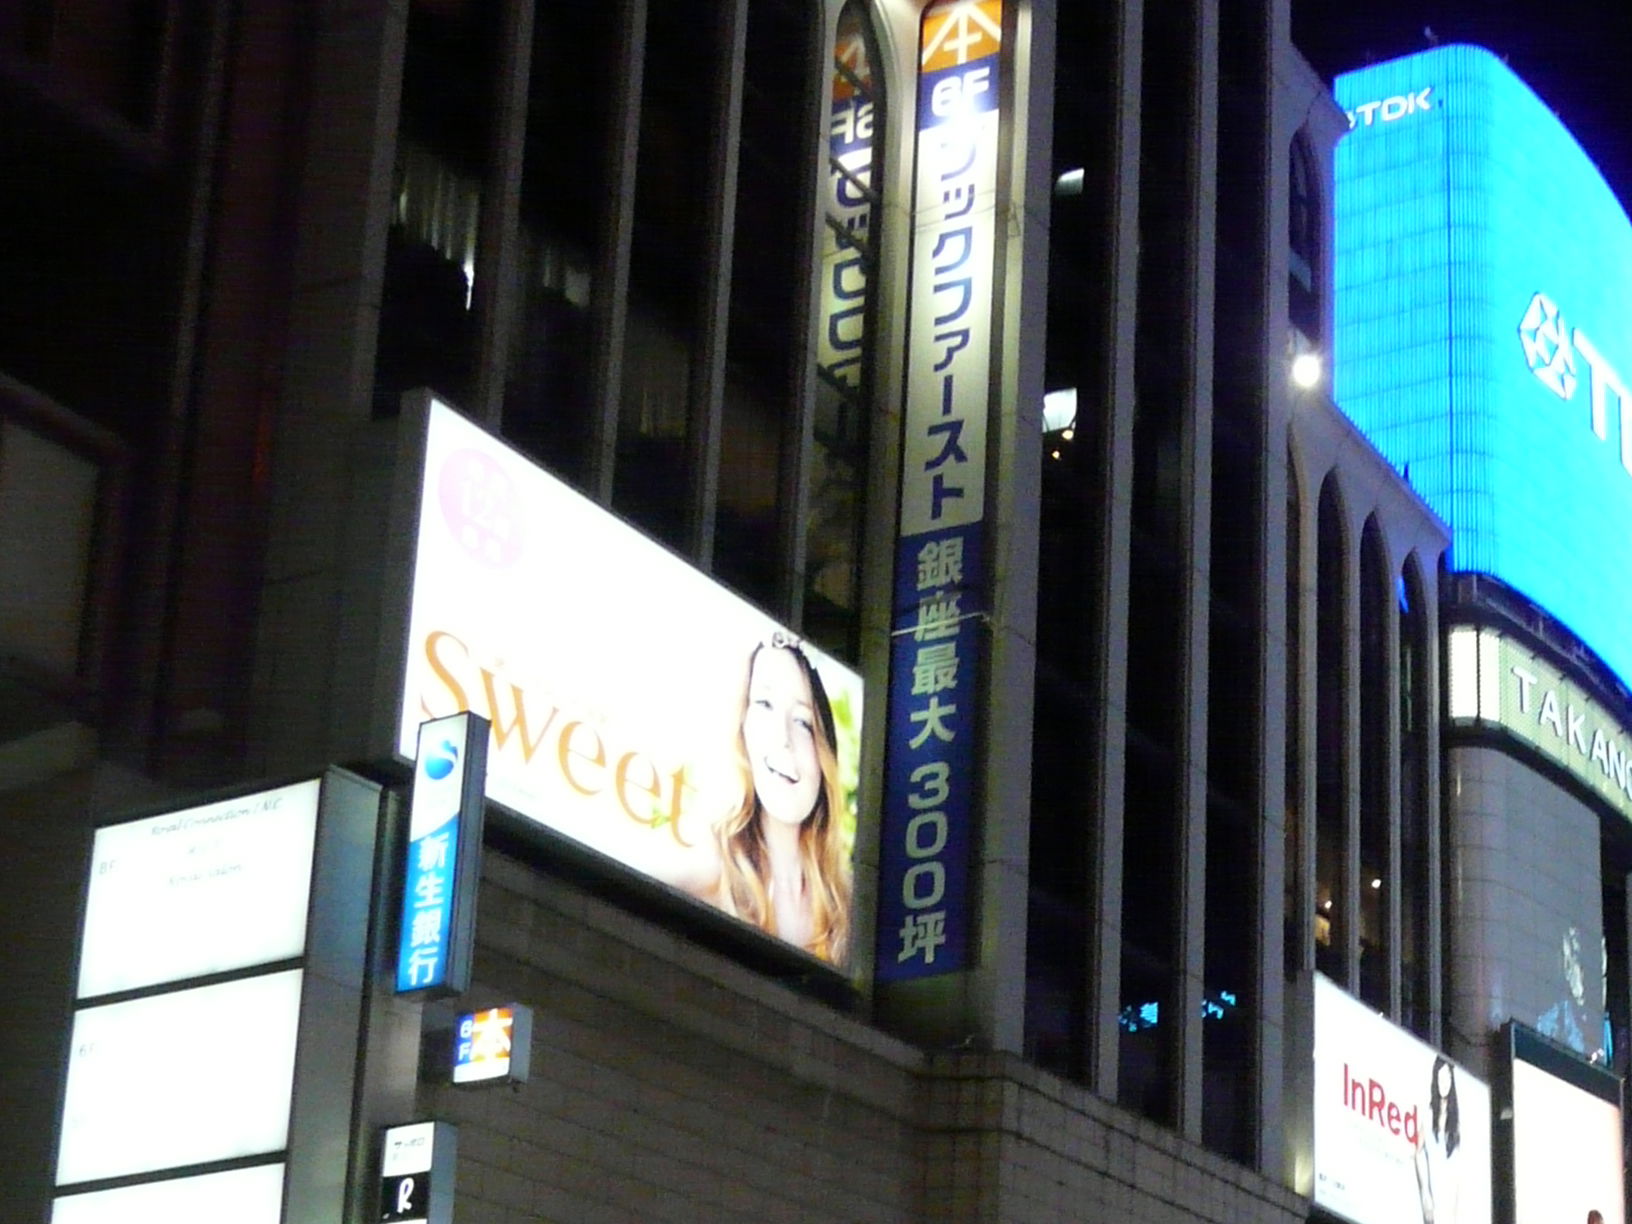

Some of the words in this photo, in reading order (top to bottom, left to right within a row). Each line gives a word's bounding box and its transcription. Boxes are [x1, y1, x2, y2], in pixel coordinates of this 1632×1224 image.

[1354, 86, 1433, 127] TDK
[420, 630, 700, 849] Sweet
[408, 831, 448, 986] 新生銀行
[1342, 1063, 1419, 1146] InRed
